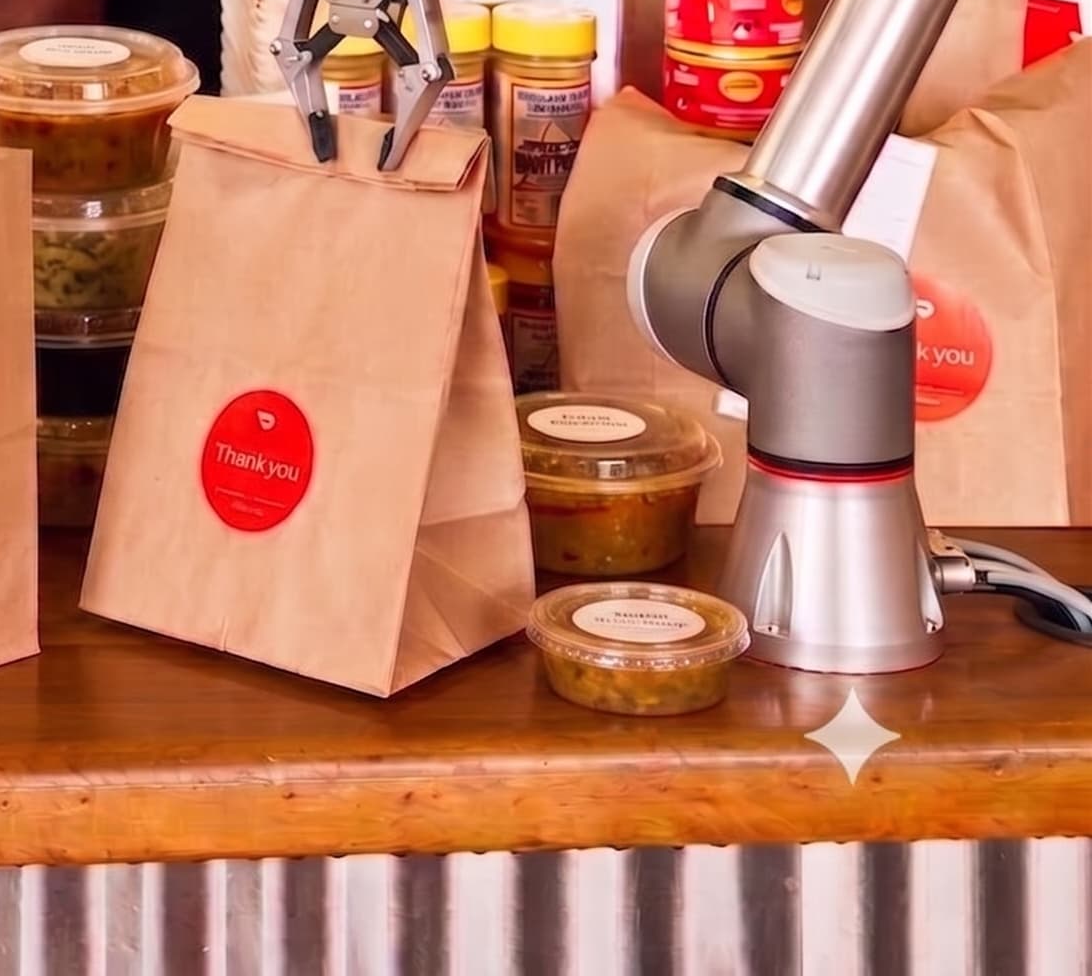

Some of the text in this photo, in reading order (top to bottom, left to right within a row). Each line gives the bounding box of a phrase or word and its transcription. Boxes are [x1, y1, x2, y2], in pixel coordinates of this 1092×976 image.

[932, 347, 975, 368] you
[215, 441, 300, 482] Thank you
